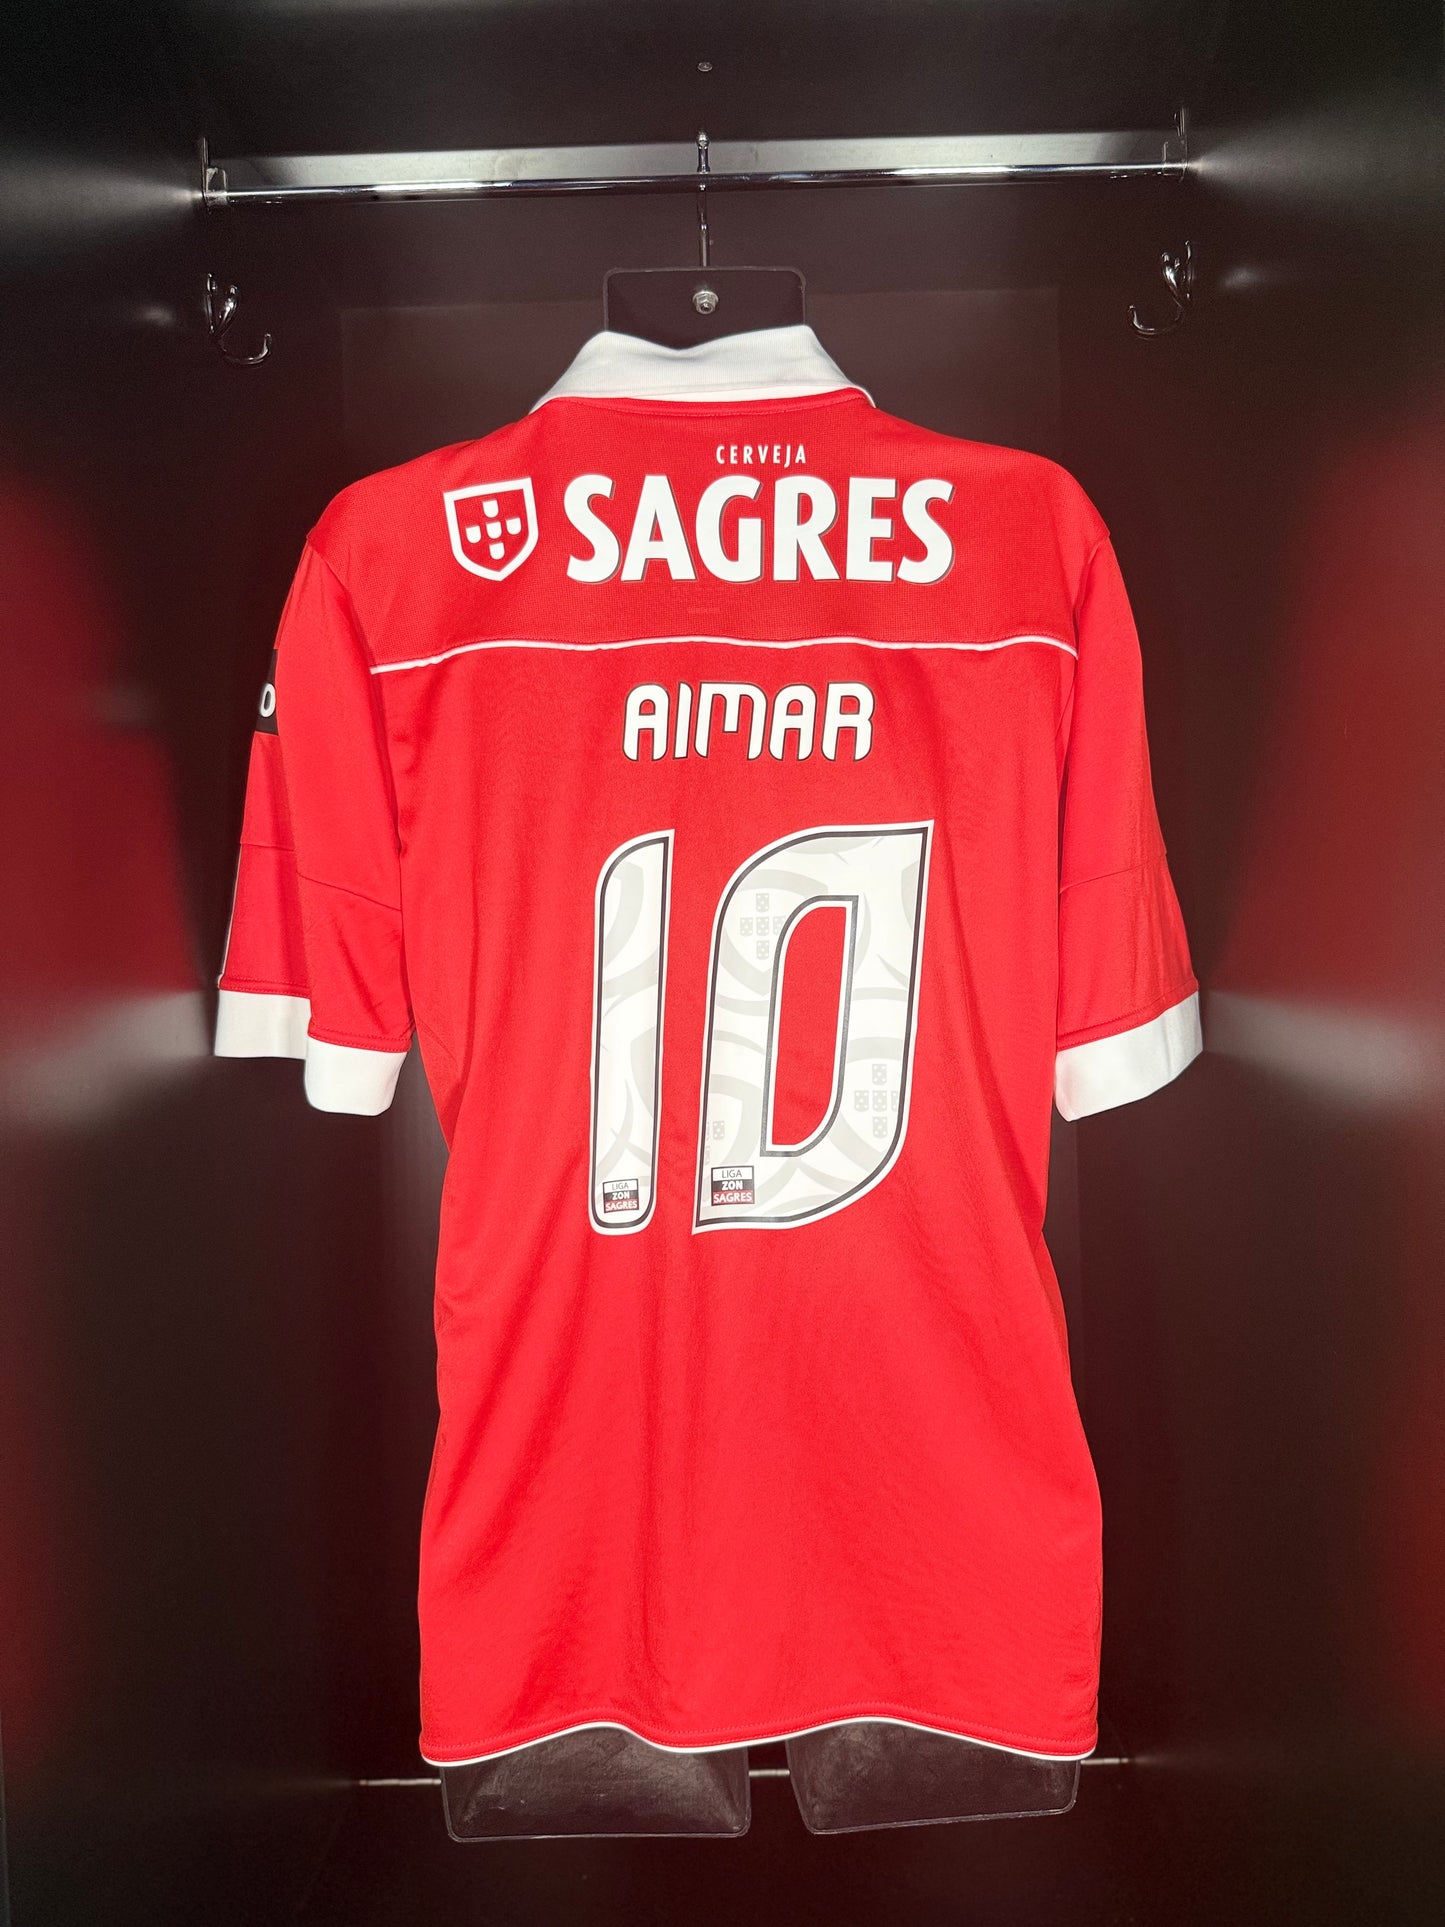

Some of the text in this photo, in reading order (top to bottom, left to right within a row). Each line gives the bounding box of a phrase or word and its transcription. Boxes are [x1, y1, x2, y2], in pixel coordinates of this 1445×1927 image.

[715, 444, 806, 468] CERVEJA
[563, 473, 956, 586] SAGRES
[622, 682, 876, 762] AIMAR
[588, 819, 935, 1236] 10
[721, 1169, 743, 1179] LIGA
[611, 1182, 629, 1191] LIGA
[721, 1180, 743, 1191] ZON
[611, 1191, 630, 1201] ZON
[713, 1192, 752, 1203] SAGRES
[605, 1200, 637, 1211] SAGRES
